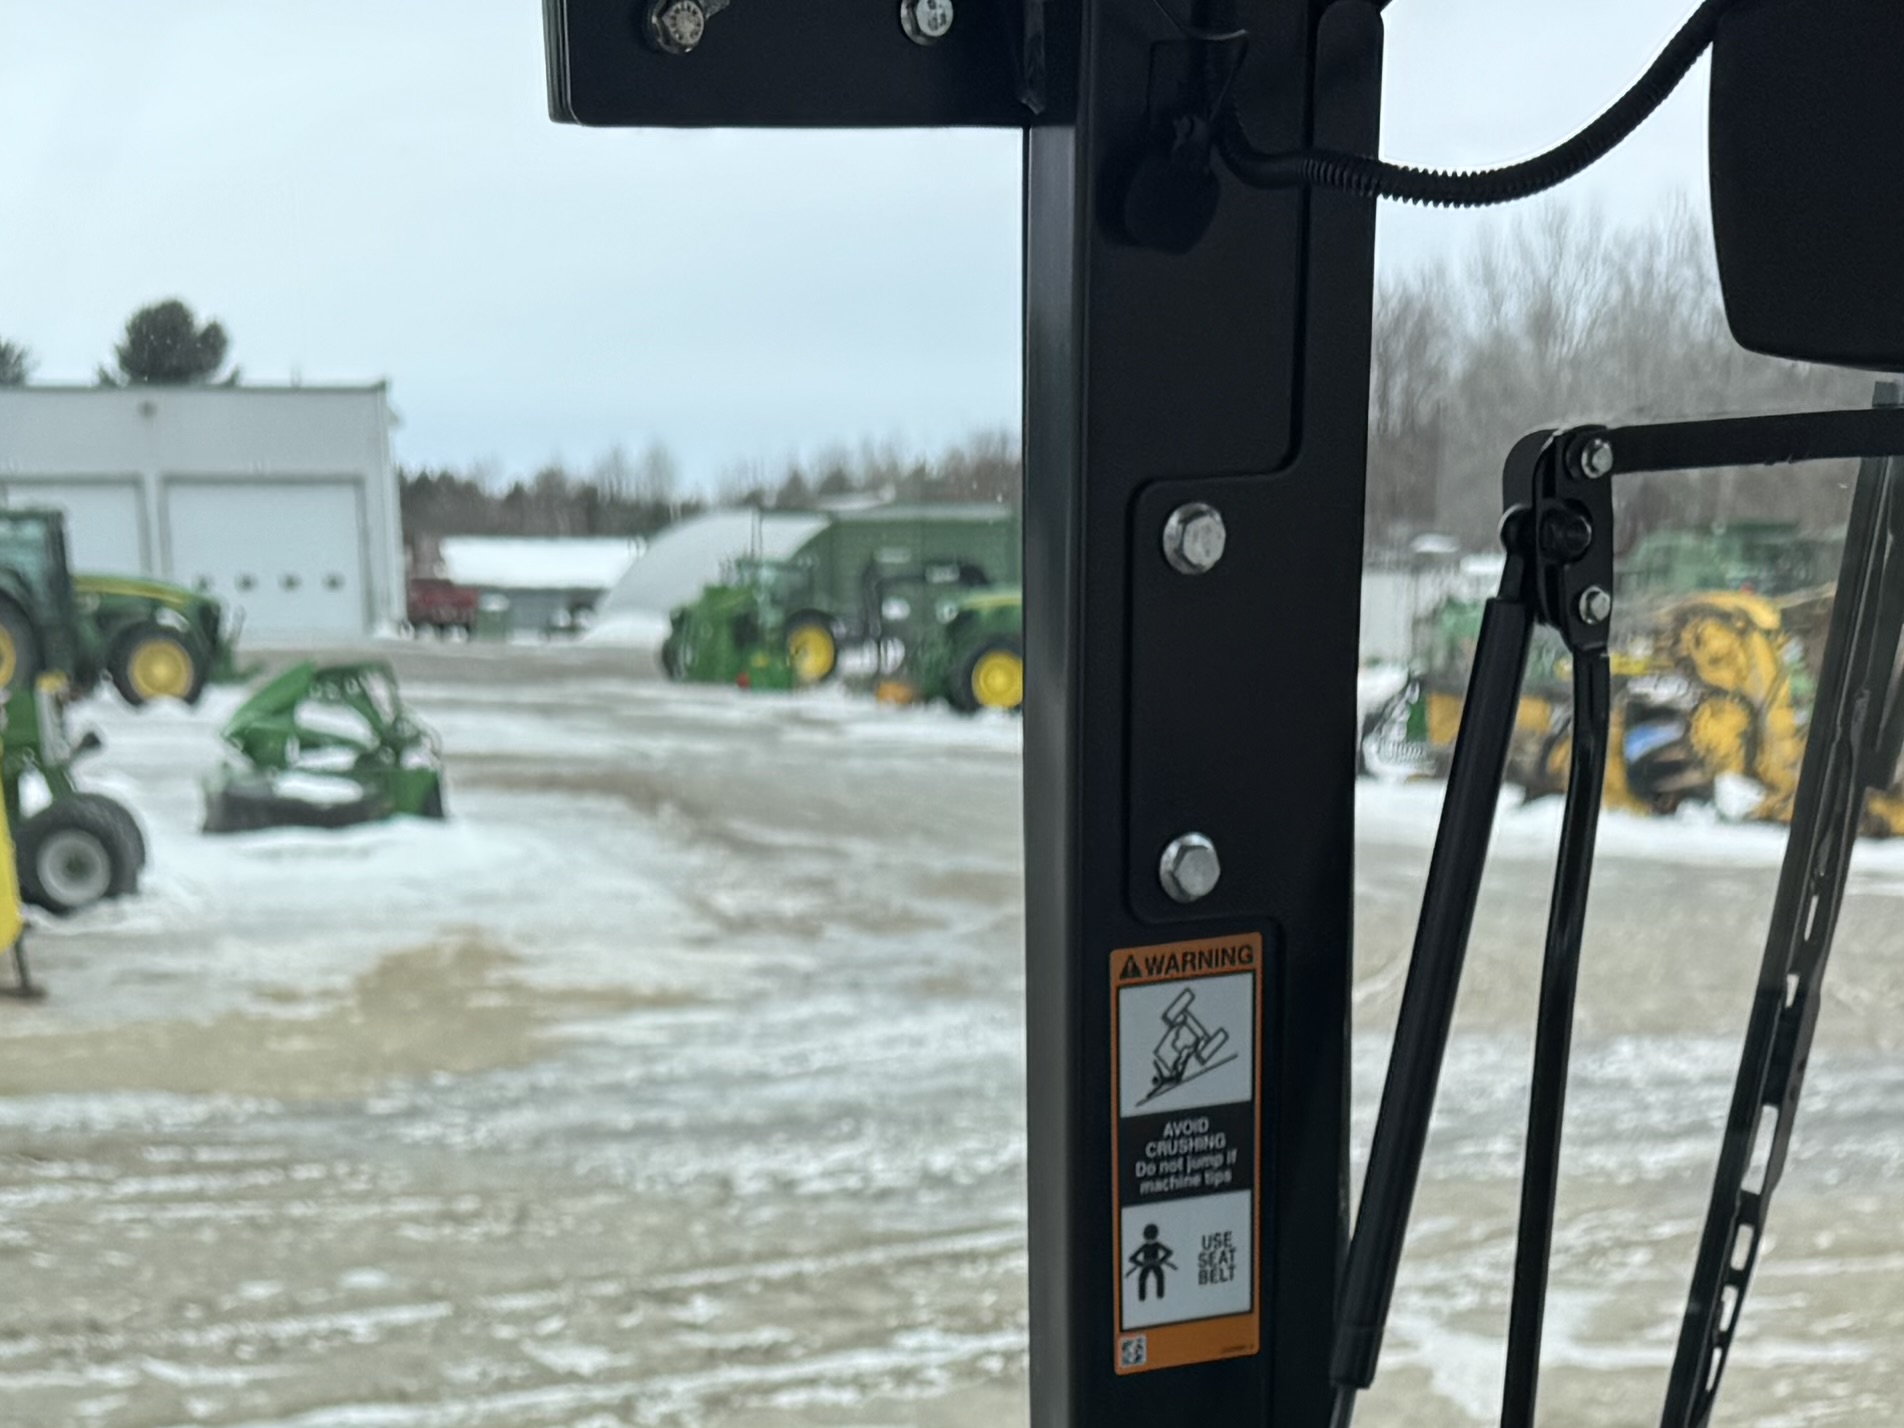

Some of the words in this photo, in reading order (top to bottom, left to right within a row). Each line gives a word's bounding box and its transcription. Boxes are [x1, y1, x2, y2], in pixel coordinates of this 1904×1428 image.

[1144, 944, 1254, 976] WARNING
[1164, 1117, 1209, 1137] AVOID
[1146, 1133, 1226, 1157] CRUSHING
[1135, 1160, 1157, 1177] Do
[1159, 1156, 1183, 1173] not
[1186, 1153, 1225, 1174] jump
[1226, 1147, 1238, 1165] if
[1140, 1175, 1202, 1195] machine
[1204, 1170, 1232, 1187] tips
[1201, 1231, 1232, 1249] USE
[1198, 1248, 1236, 1267] SEAT
[1198, 1266, 1235, 1286] BELT
